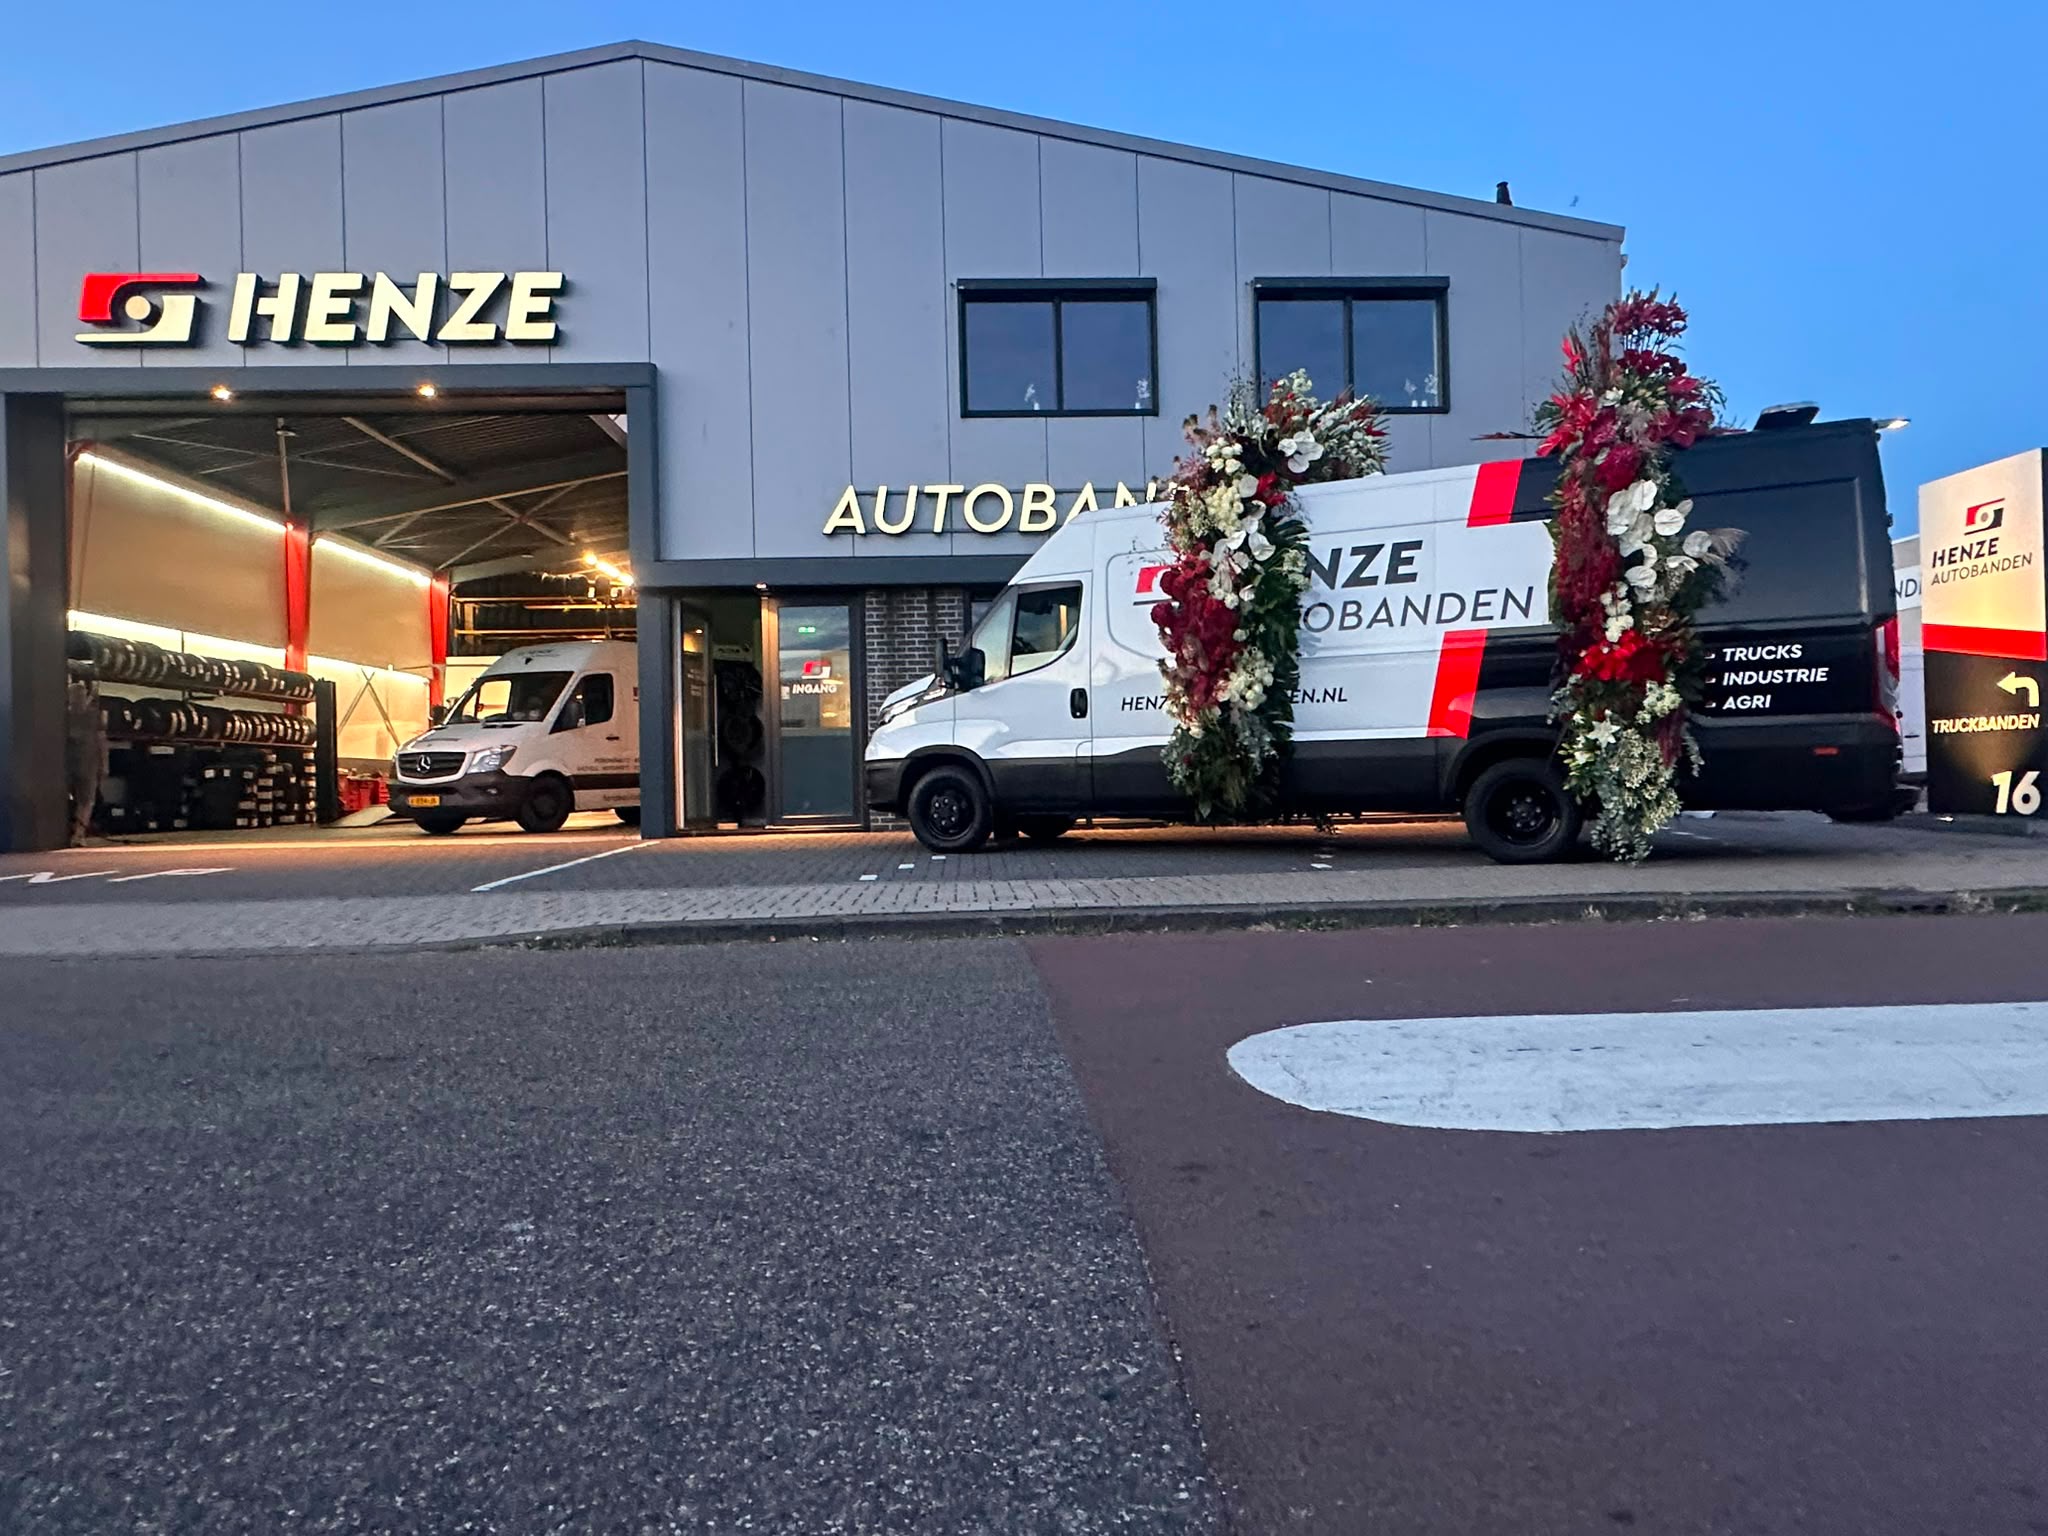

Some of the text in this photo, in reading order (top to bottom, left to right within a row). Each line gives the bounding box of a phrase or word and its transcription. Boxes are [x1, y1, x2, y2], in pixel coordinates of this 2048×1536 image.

[227, 272, 564, 342] HENZE
[1931, 537, 2000, 568] HENZE
[1930, 552, 2033, 586] AUTOBANDEN
[1722, 644, 1803, 662] TRUCKS
[1722, 667, 1830, 686] INDUSTRIE
[792, 683, 838, 695] INGANG
[1722, 694, 1772, 710] AGRI
[1932, 713, 2041, 734] TRUCKBANDEN
[1991, 770, 2041, 815] 16
